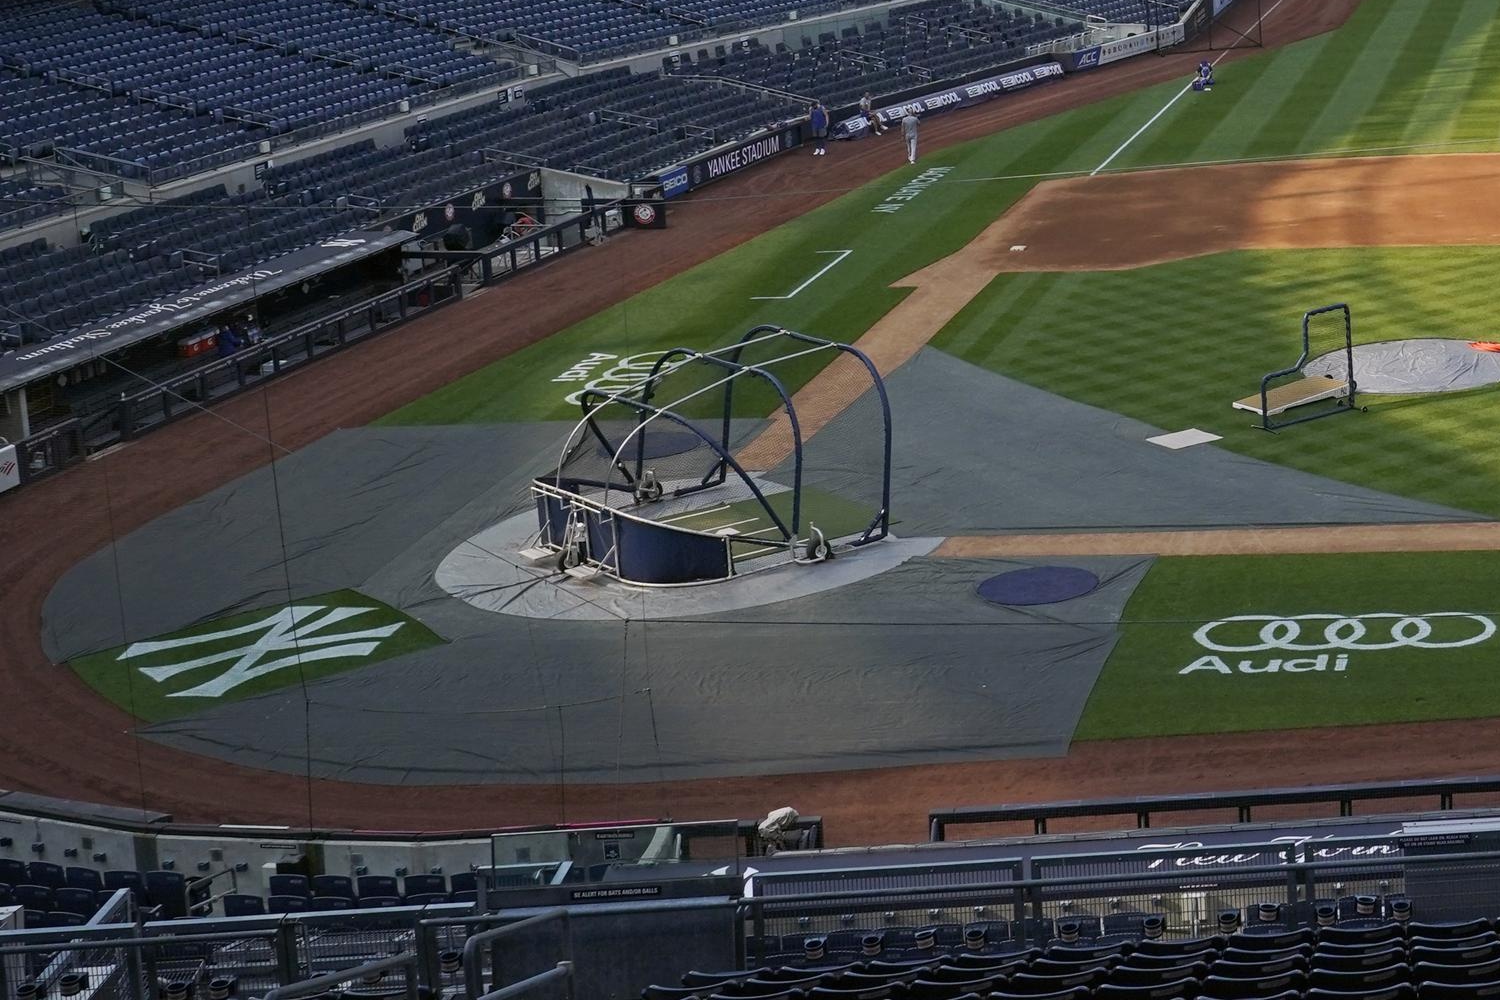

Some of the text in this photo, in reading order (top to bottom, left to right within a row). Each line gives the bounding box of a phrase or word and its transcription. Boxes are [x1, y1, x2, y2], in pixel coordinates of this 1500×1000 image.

[1079, 51, 1097, 65] ACC
[707, 136, 780, 178] YANKEE STADIUM
[662, 173, 688, 191] GEICO
[14, 268, 283, 362] Welcome to Yankee Stadium
[551, 352, 619, 383] Audi
[1179, 653, 1349, 675] Audi
